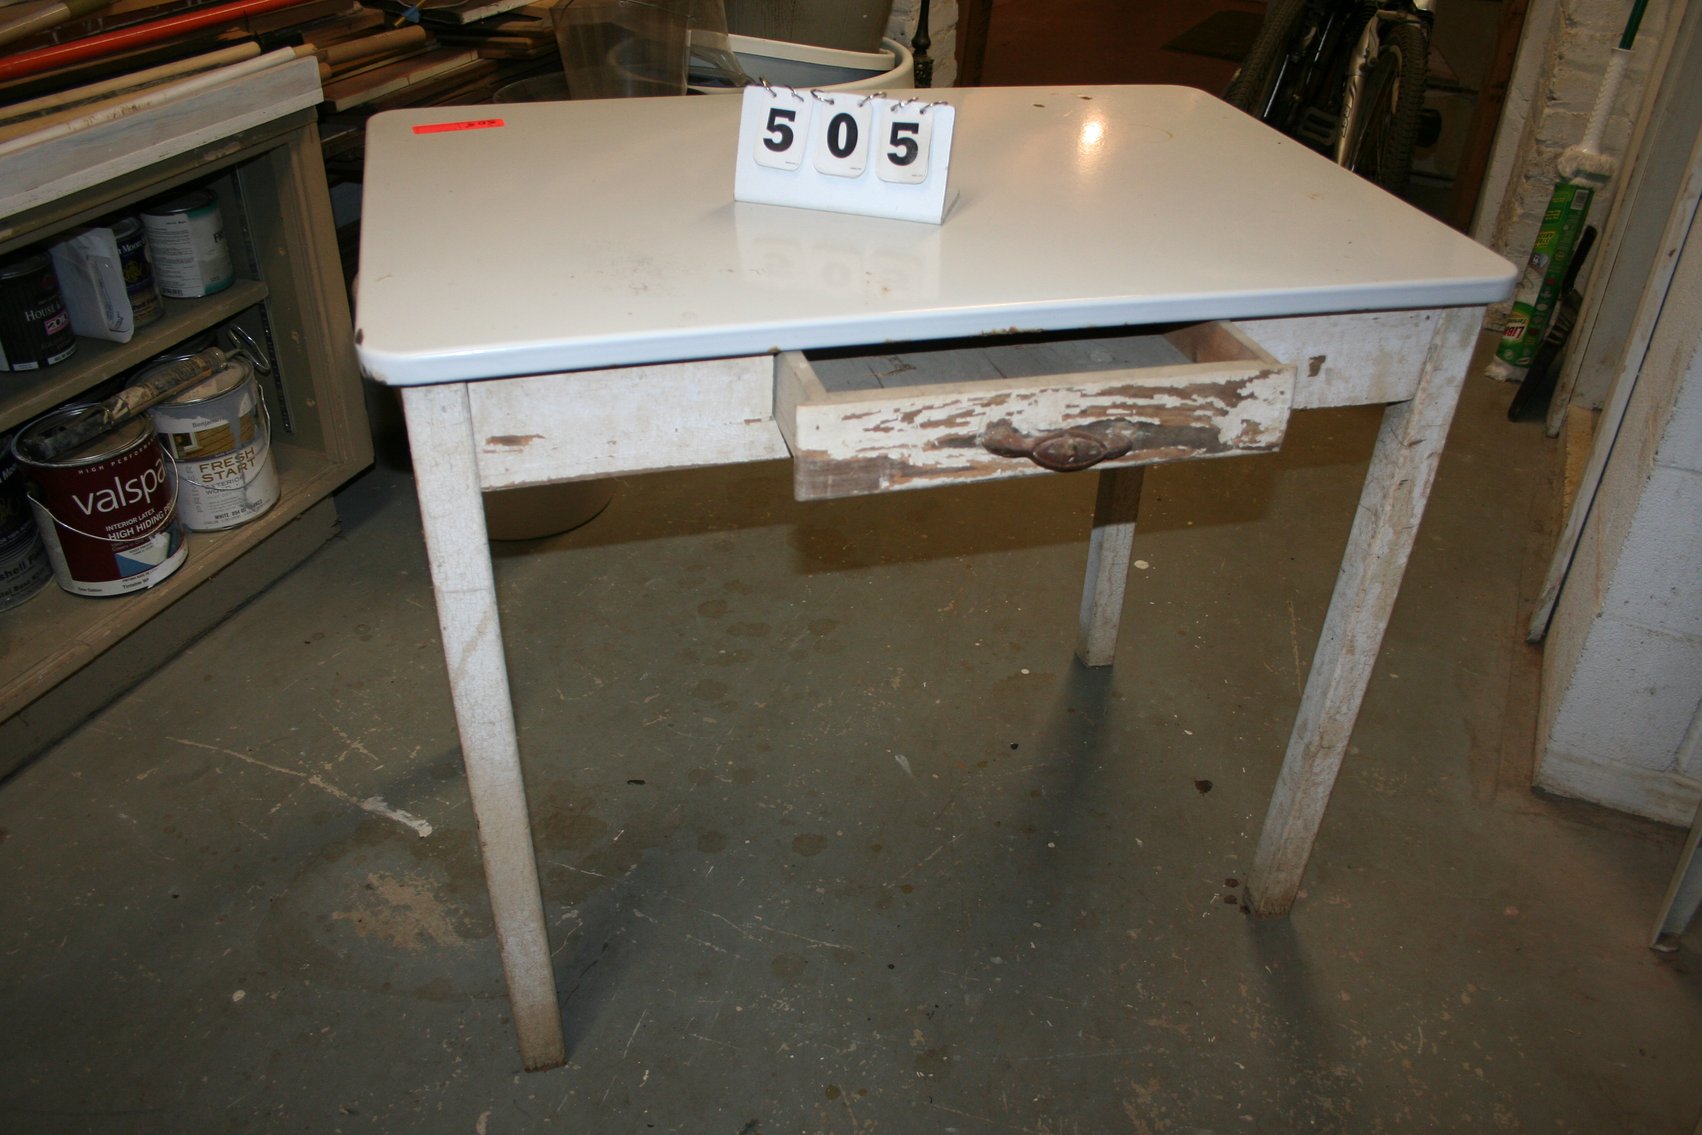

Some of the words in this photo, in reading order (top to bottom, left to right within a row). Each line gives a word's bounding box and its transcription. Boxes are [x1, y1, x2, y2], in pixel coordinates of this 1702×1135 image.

[763, 107, 920, 166] 505
[199, 447, 255, 473] FRESH
[202, 457, 257, 483] START
[105, 516, 139, 532] INTERIOR
[137, 507, 156, 522] LATEX
[108, 527, 135, 541] HIGH
[136, 510, 165, 533] HIDING
